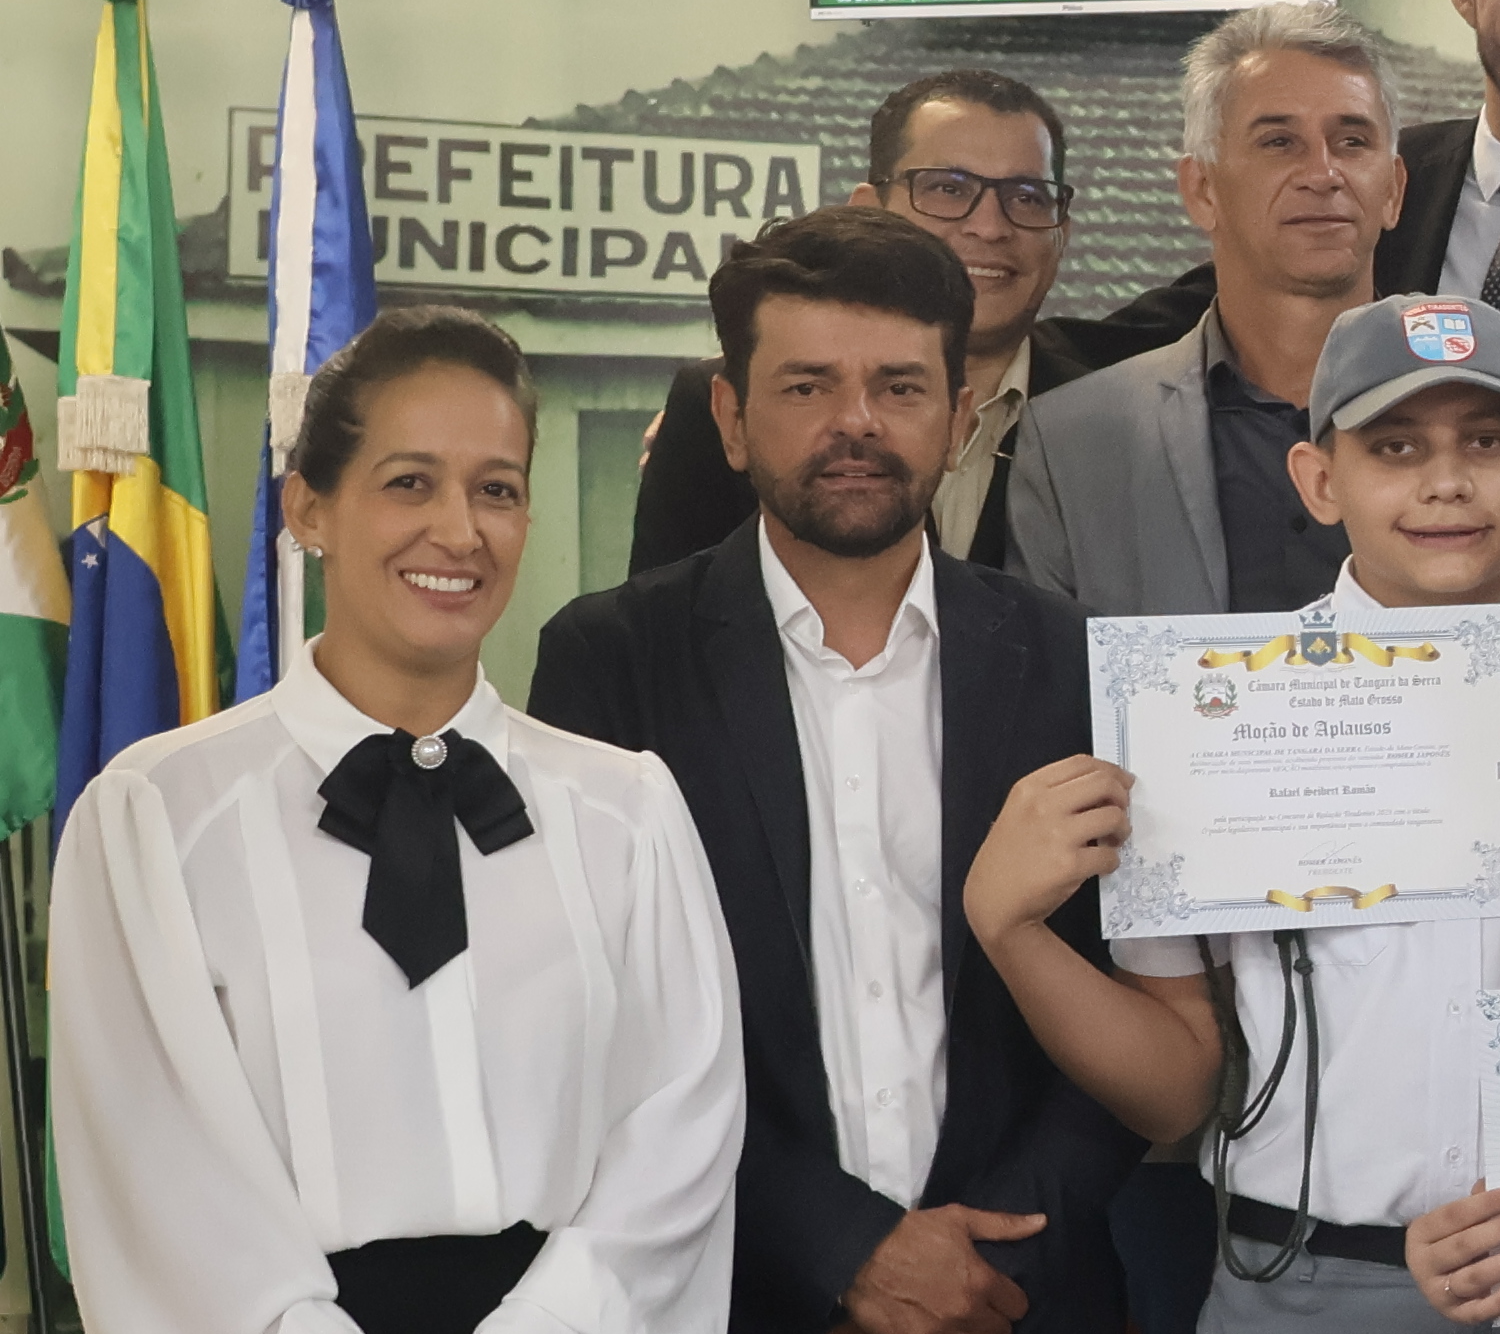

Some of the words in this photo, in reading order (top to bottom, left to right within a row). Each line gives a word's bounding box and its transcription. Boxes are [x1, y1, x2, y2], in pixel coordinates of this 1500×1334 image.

[1233, 722, 1286, 742] Moção
[1292, 723, 1309, 737] de
[1315, 721, 1391, 738] Aplausos
